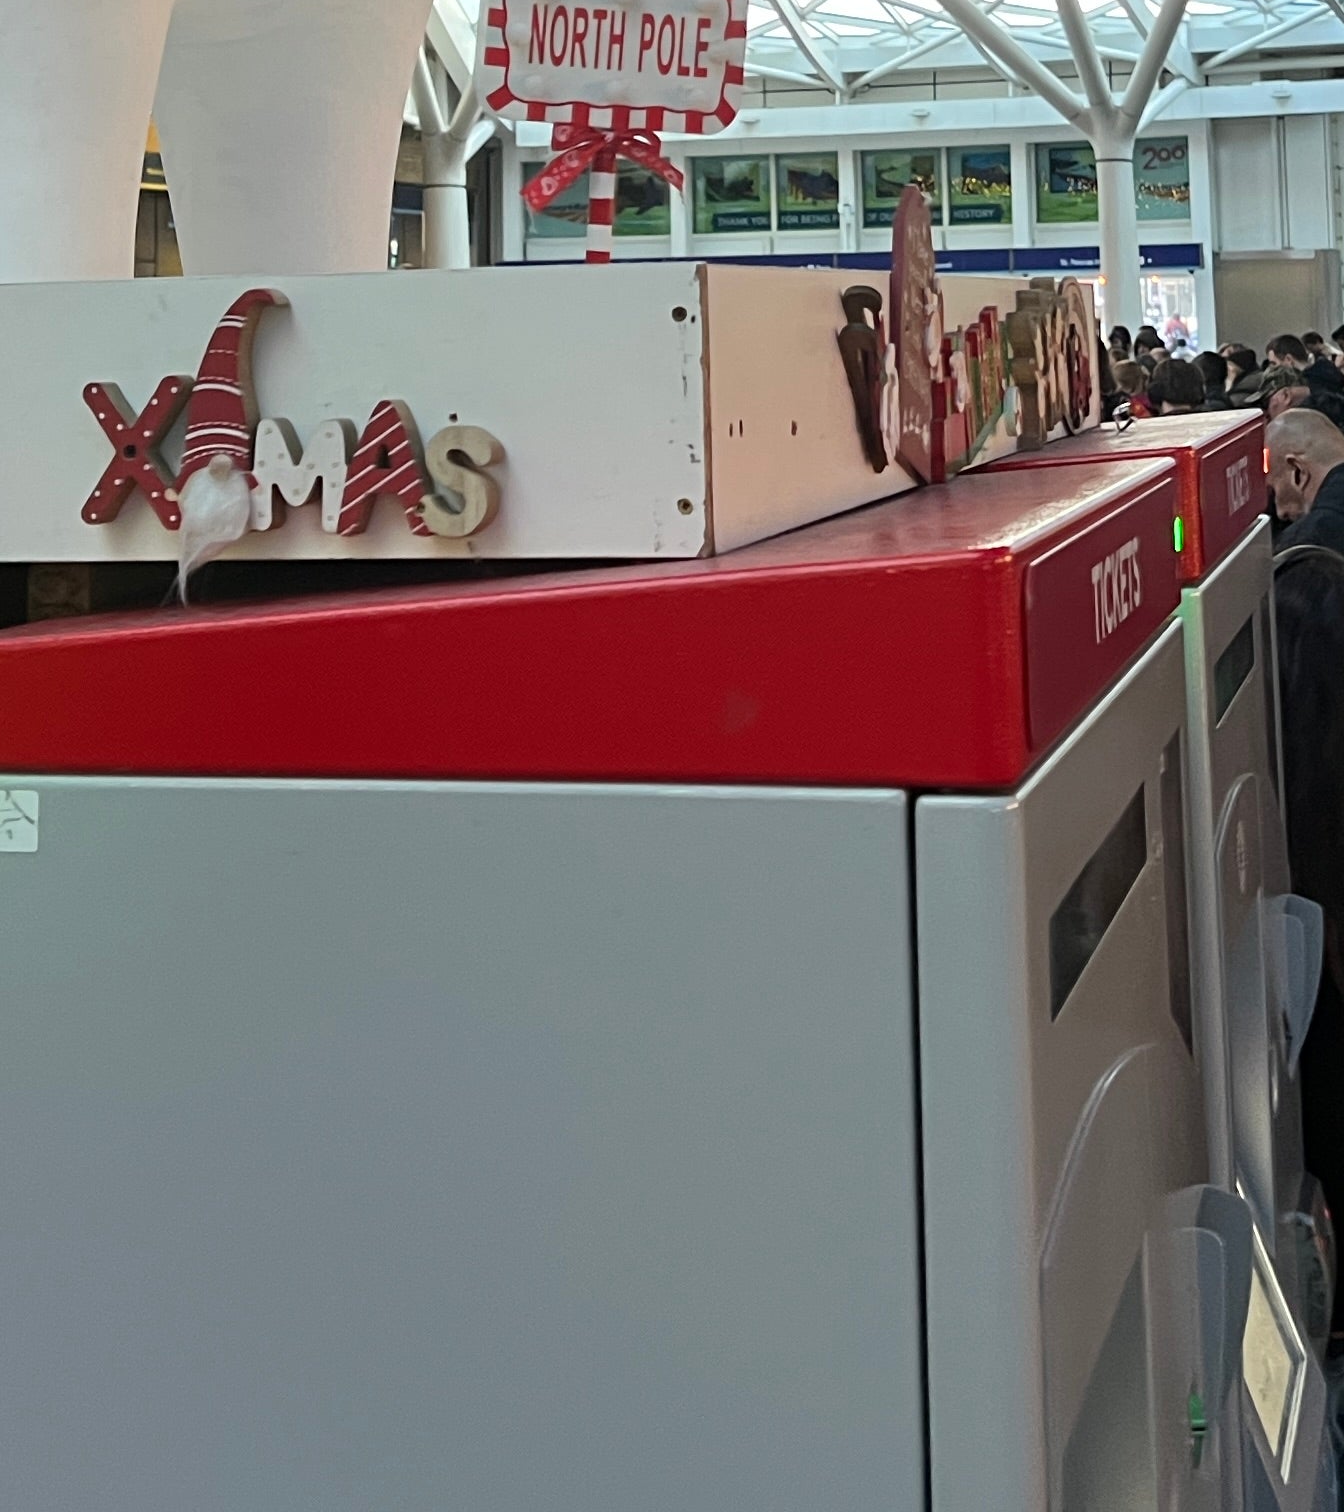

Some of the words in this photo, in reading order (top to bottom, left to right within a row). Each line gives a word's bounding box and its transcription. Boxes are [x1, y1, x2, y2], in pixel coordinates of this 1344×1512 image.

[528, 3, 626, 71] NORTH
[638, 13, 711, 78] POLE
[1091, 537, 1142, 645] TICKETS
